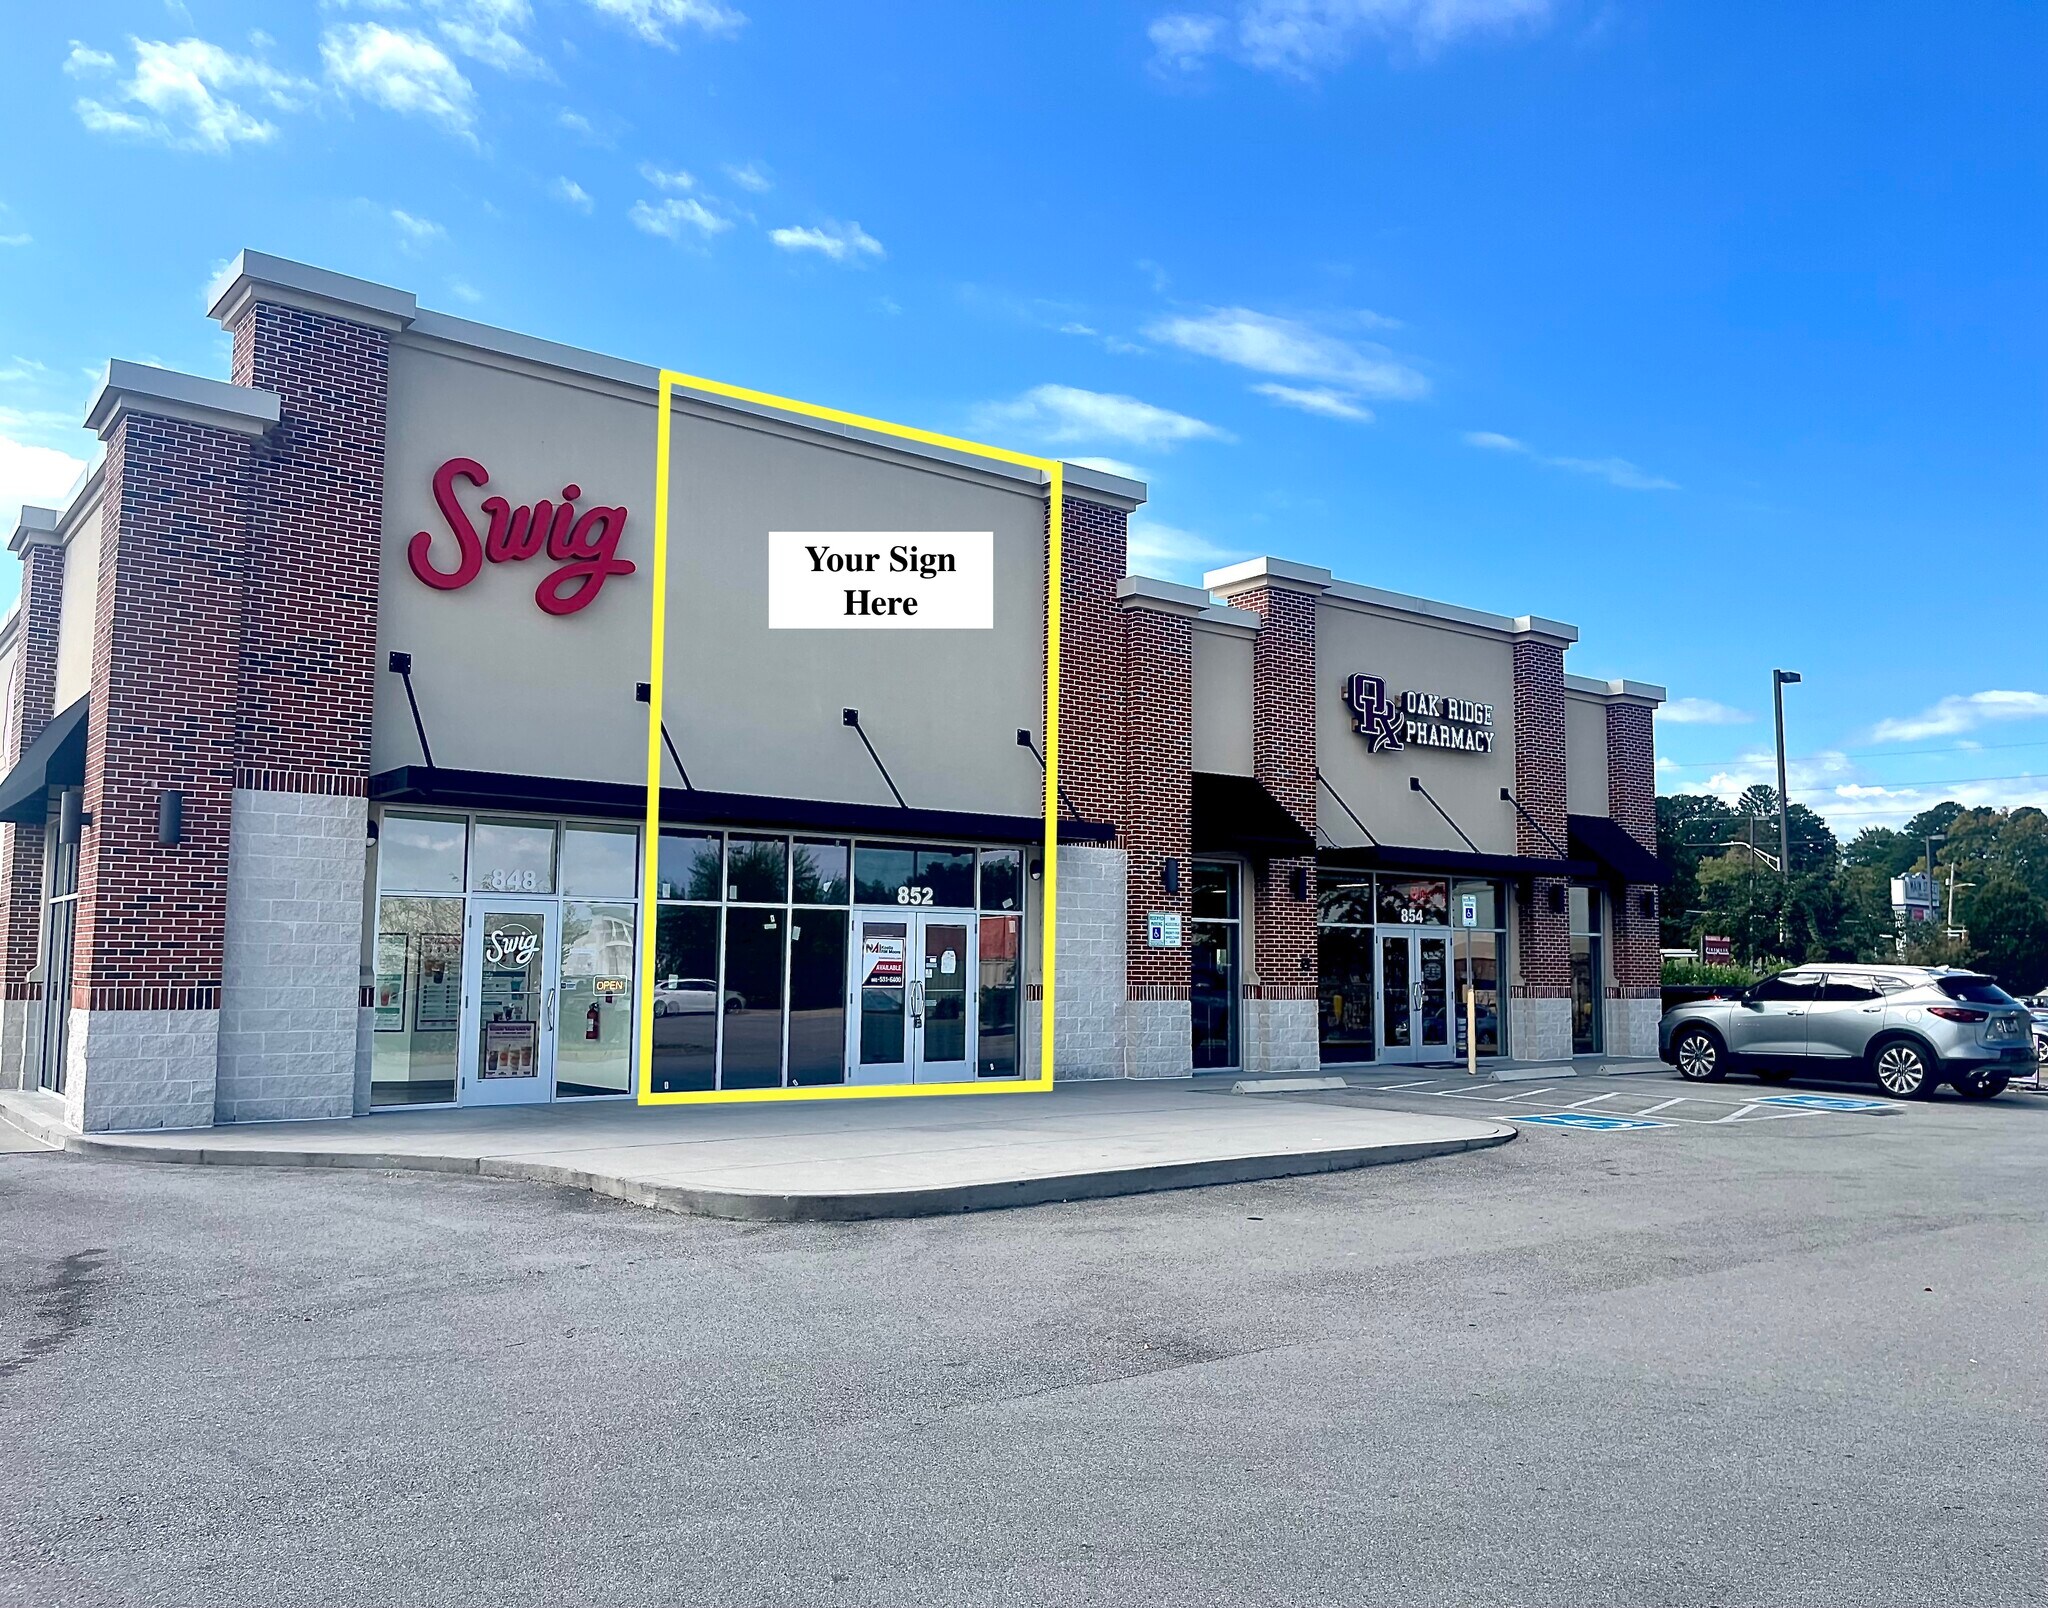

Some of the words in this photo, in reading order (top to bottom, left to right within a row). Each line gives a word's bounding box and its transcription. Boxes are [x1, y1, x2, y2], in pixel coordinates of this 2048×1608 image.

[408, 457, 636, 616] Swig
[1406, 691, 1440, 717] OAK
[1447, 698, 1494, 726] RIDGE
[1405, 720, 1495, 753] PHARMACY
[491, 868, 536, 890] 848
[897, 886, 934, 905] 852
[1401, 908, 1424, 924] 854
[486, 930, 540, 964] Swig
[596, 980, 624, 991] OPEN
